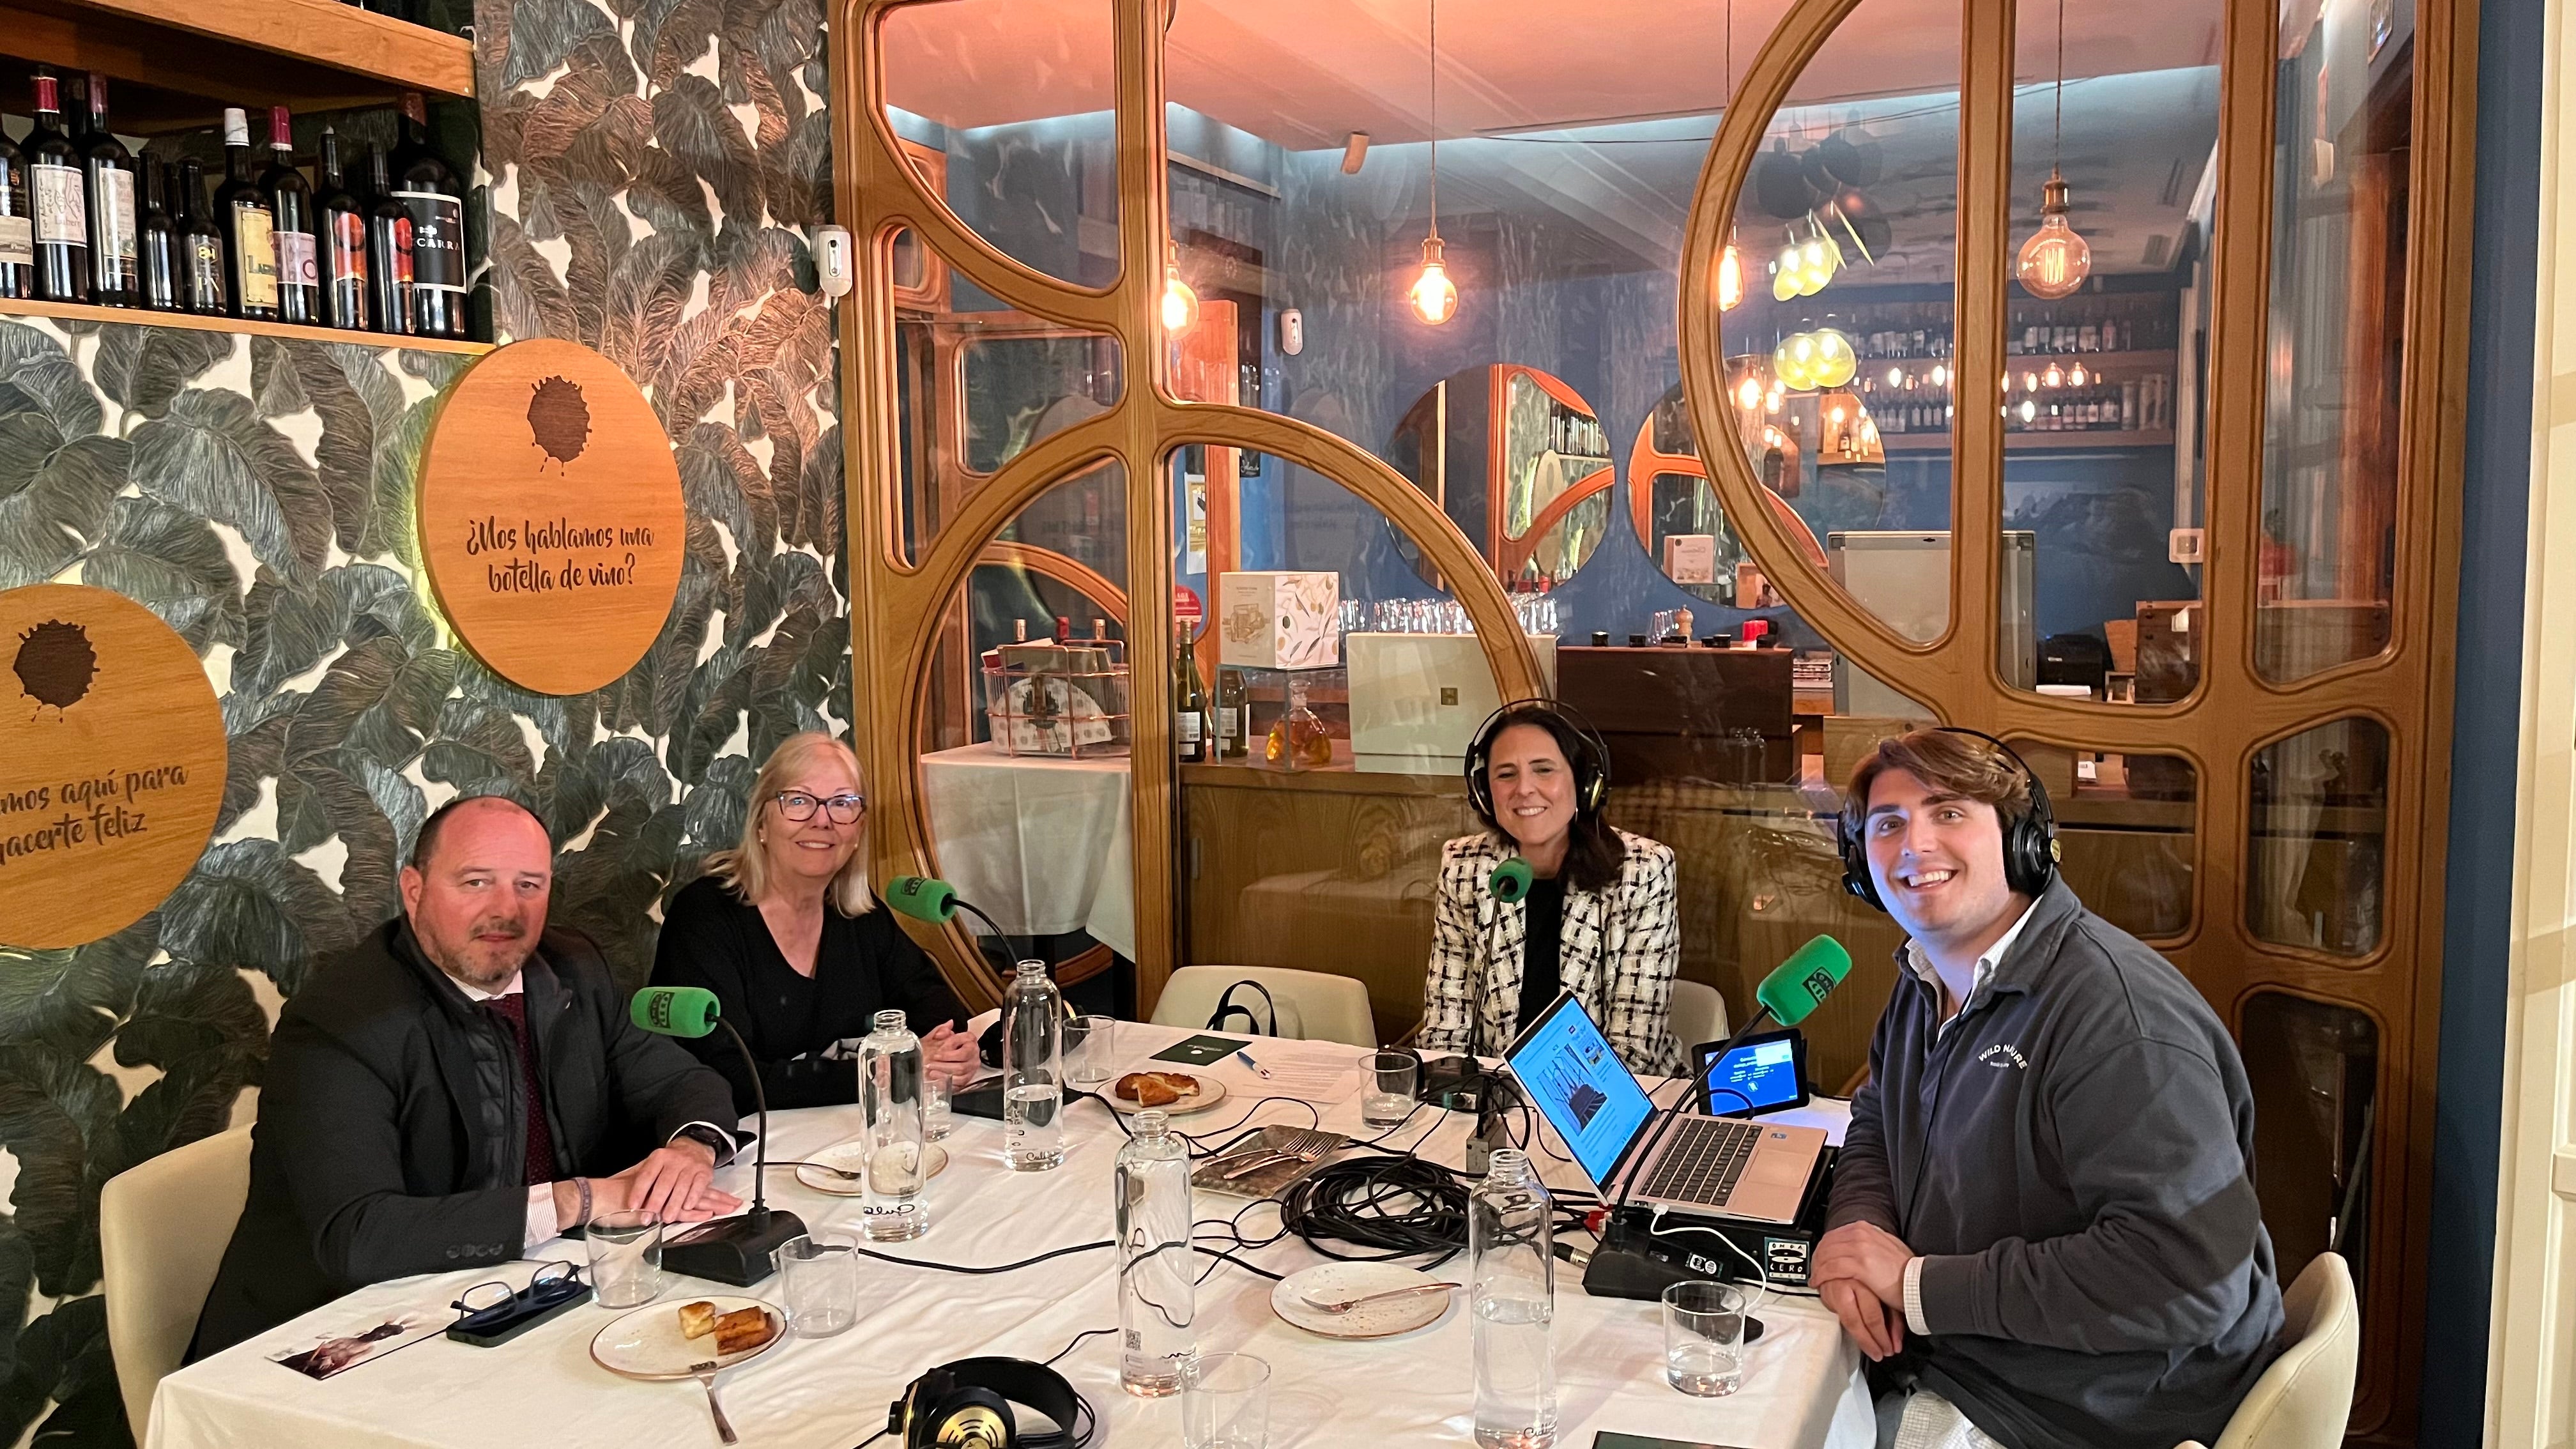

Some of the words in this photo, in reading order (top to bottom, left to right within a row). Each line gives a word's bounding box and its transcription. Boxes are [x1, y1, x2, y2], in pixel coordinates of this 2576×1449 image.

[467, 515, 517, 555] ¿Nos
[525, 517, 613, 555] hablamos
[620, 527, 655, 547] una
[488, 557, 556, 594] botella
[560, 558, 585, 590] de
[588, 552, 636, 586] vino?
[61, 769, 119, 812] aquí
[125, 766, 190, 804] para
[88, 803, 148, 846] feliz
[1978, 1044, 2002, 1062] WILD
[1772, 1243, 1804, 1251] ONDA
